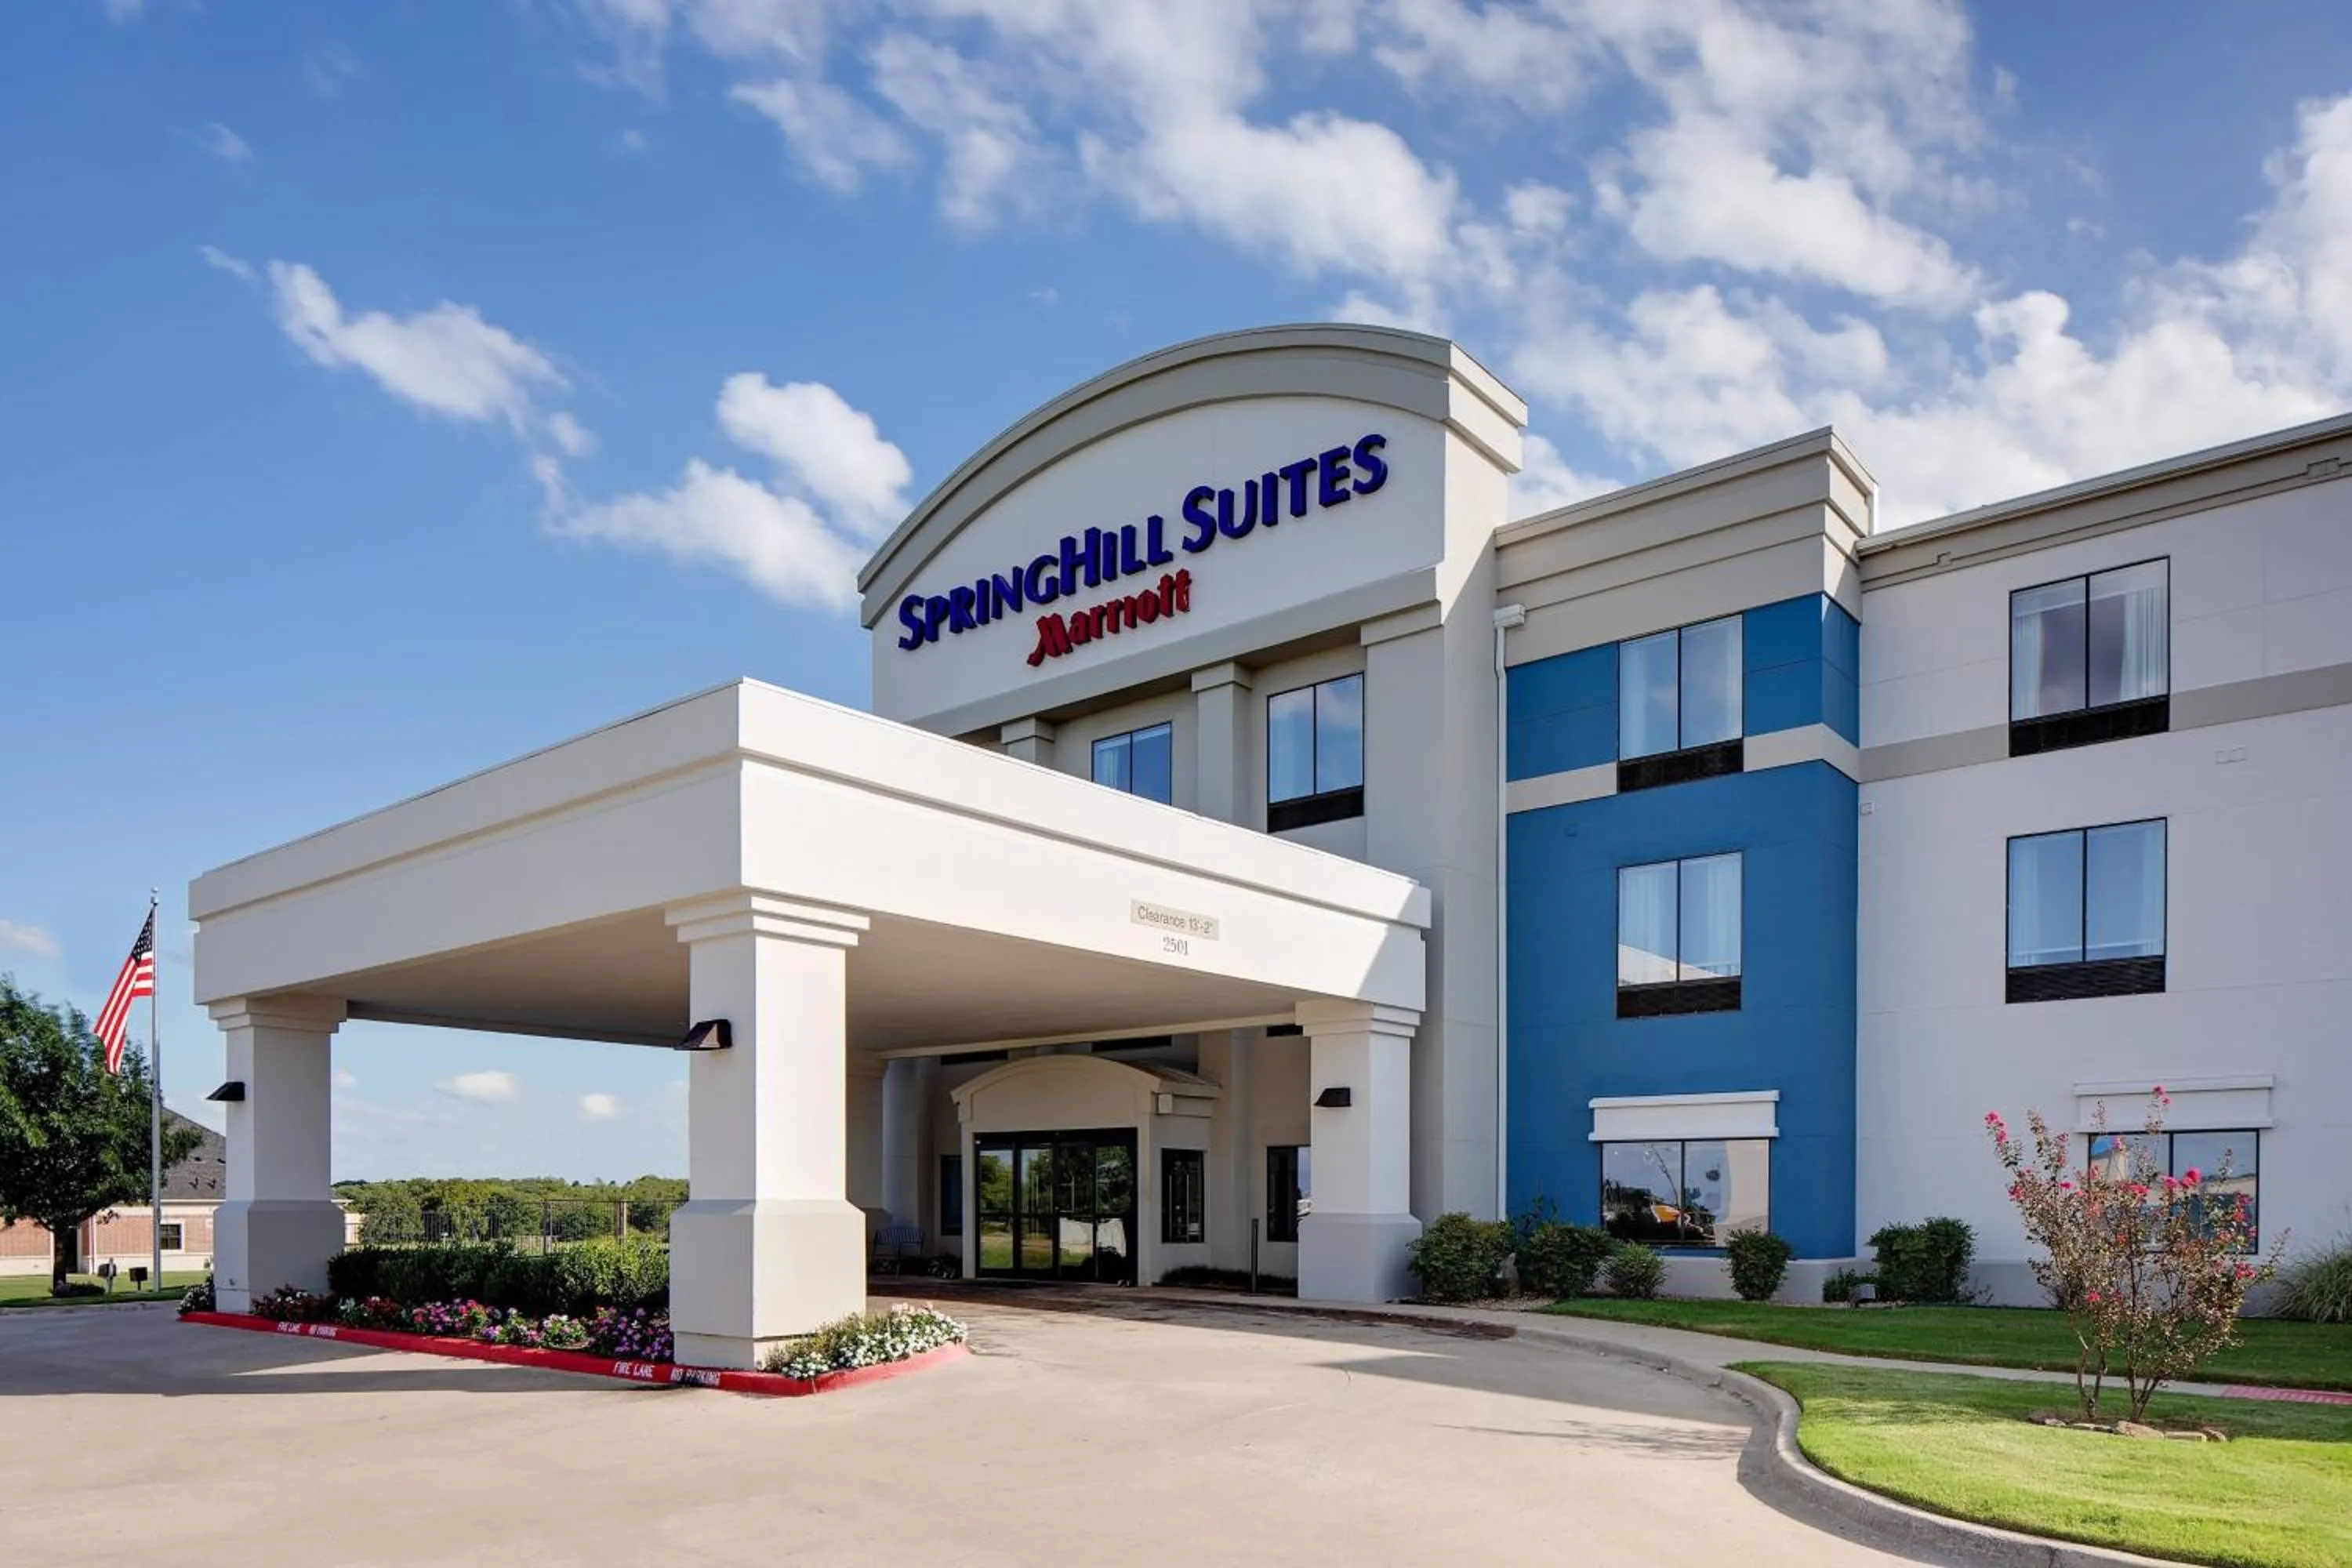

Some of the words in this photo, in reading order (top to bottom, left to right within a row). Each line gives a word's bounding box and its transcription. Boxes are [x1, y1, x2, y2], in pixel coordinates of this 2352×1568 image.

[898, 514, 1173, 652] SPRINGHILL
[1181, 434, 1389, 554] SUITES
[1027, 568, 1192, 666] Marriott
[1137, 905, 1185, 929] Clearance
[1163, 936, 1189, 955] 2501
[613, 1362, 632, 1374] FIRE
[633, 1363, 654, 1378] LANE
[670, 1367, 684, 1381] NO
